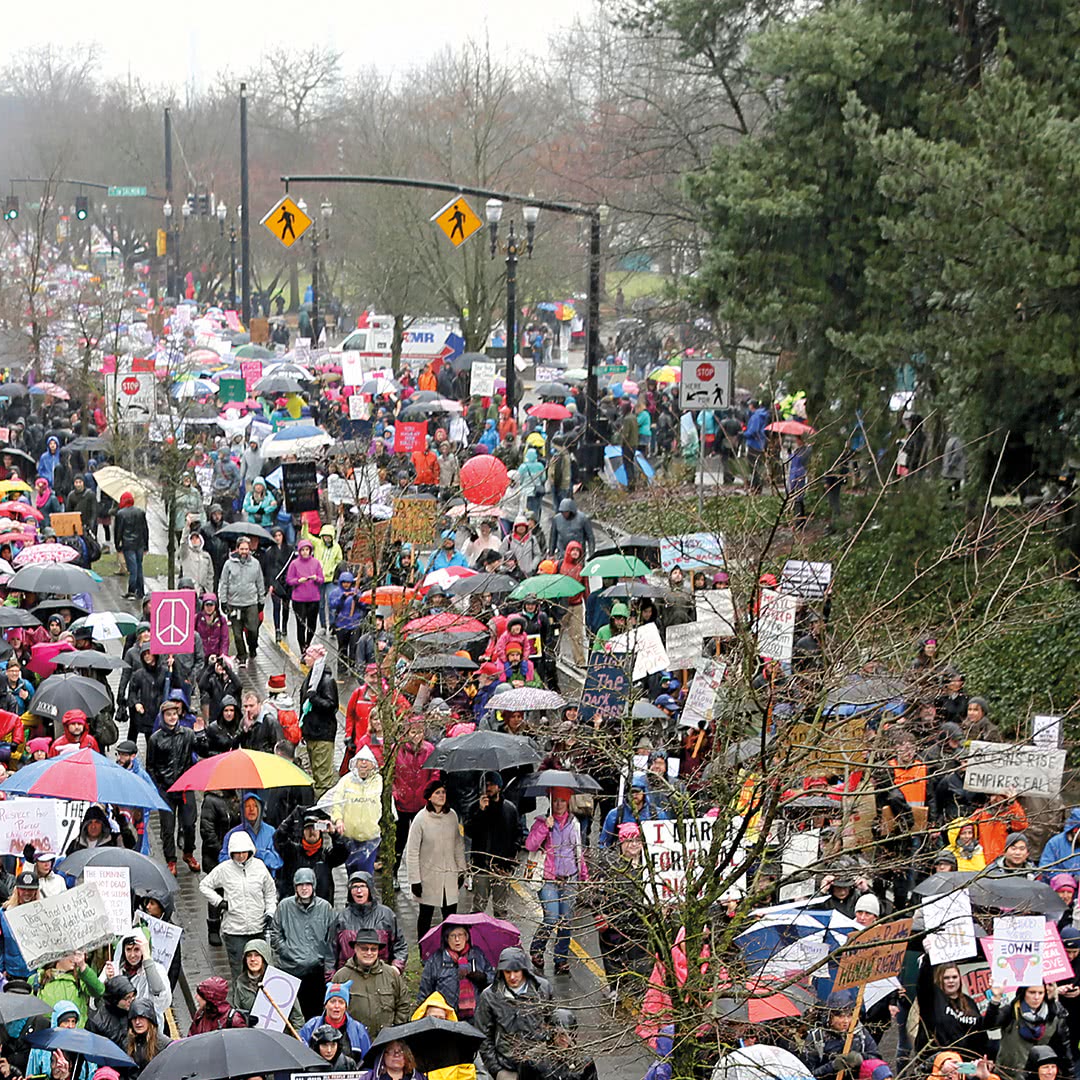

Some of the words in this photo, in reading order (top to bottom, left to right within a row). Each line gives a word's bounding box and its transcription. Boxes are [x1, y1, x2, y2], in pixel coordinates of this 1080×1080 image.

[697, 368, 714, 376] STOP
[122, 381, 138, 391] STOP
[1027, 753, 1056, 768] RISE
[968, 772, 1021, 788] EMPIRES
[64, 802, 85, 818] THE
[653, 824, 664, 844] I
[1008, 943, 1032, 954] OWN
